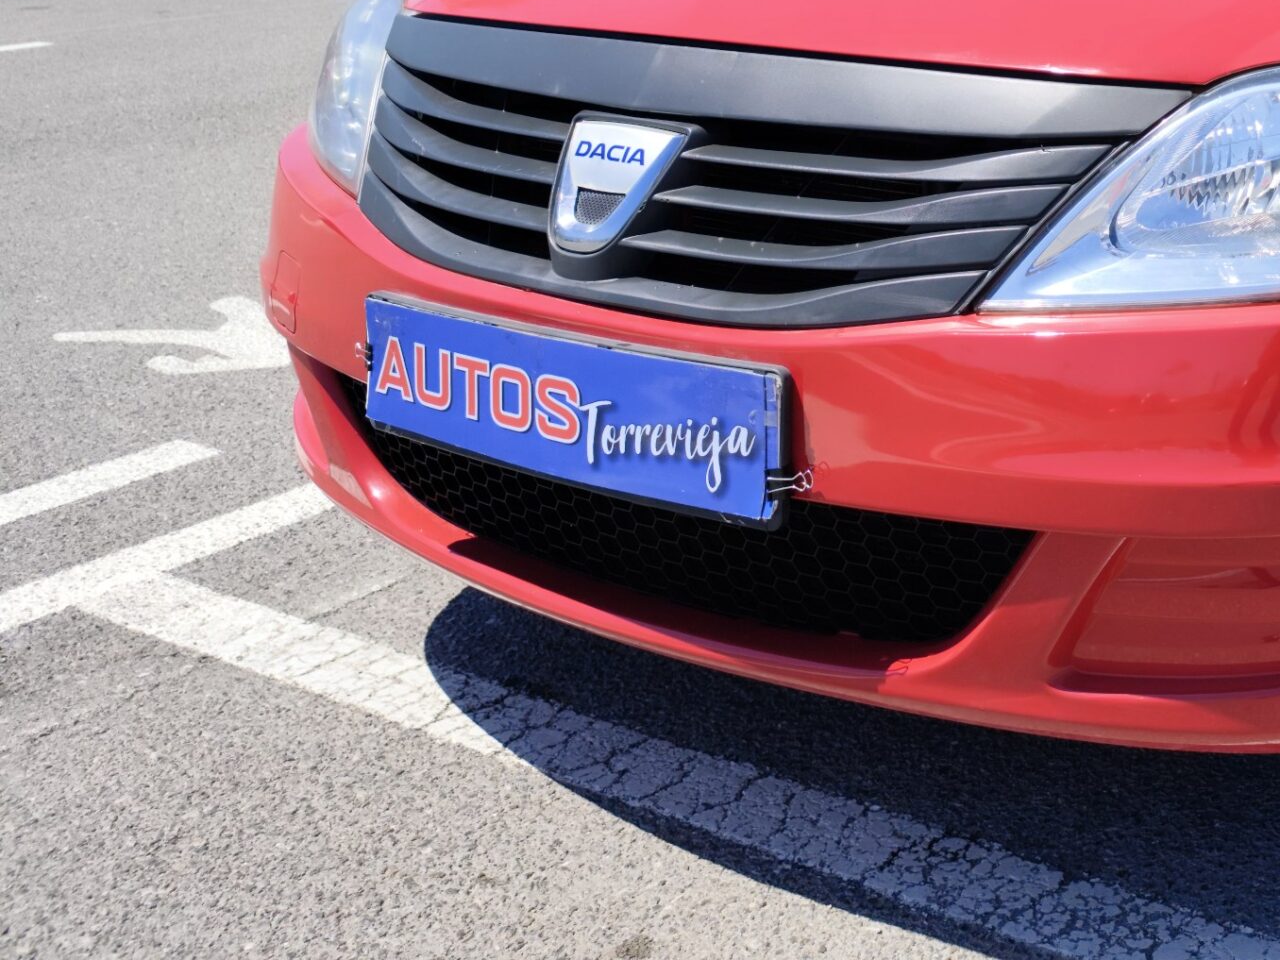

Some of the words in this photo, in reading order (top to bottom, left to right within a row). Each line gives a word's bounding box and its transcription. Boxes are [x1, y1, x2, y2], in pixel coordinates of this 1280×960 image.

[575, 140, 645, 166] DACIA
[376, 336, 581, 445] AUTOS
[578, 400, 756, 493] Torrevieja
